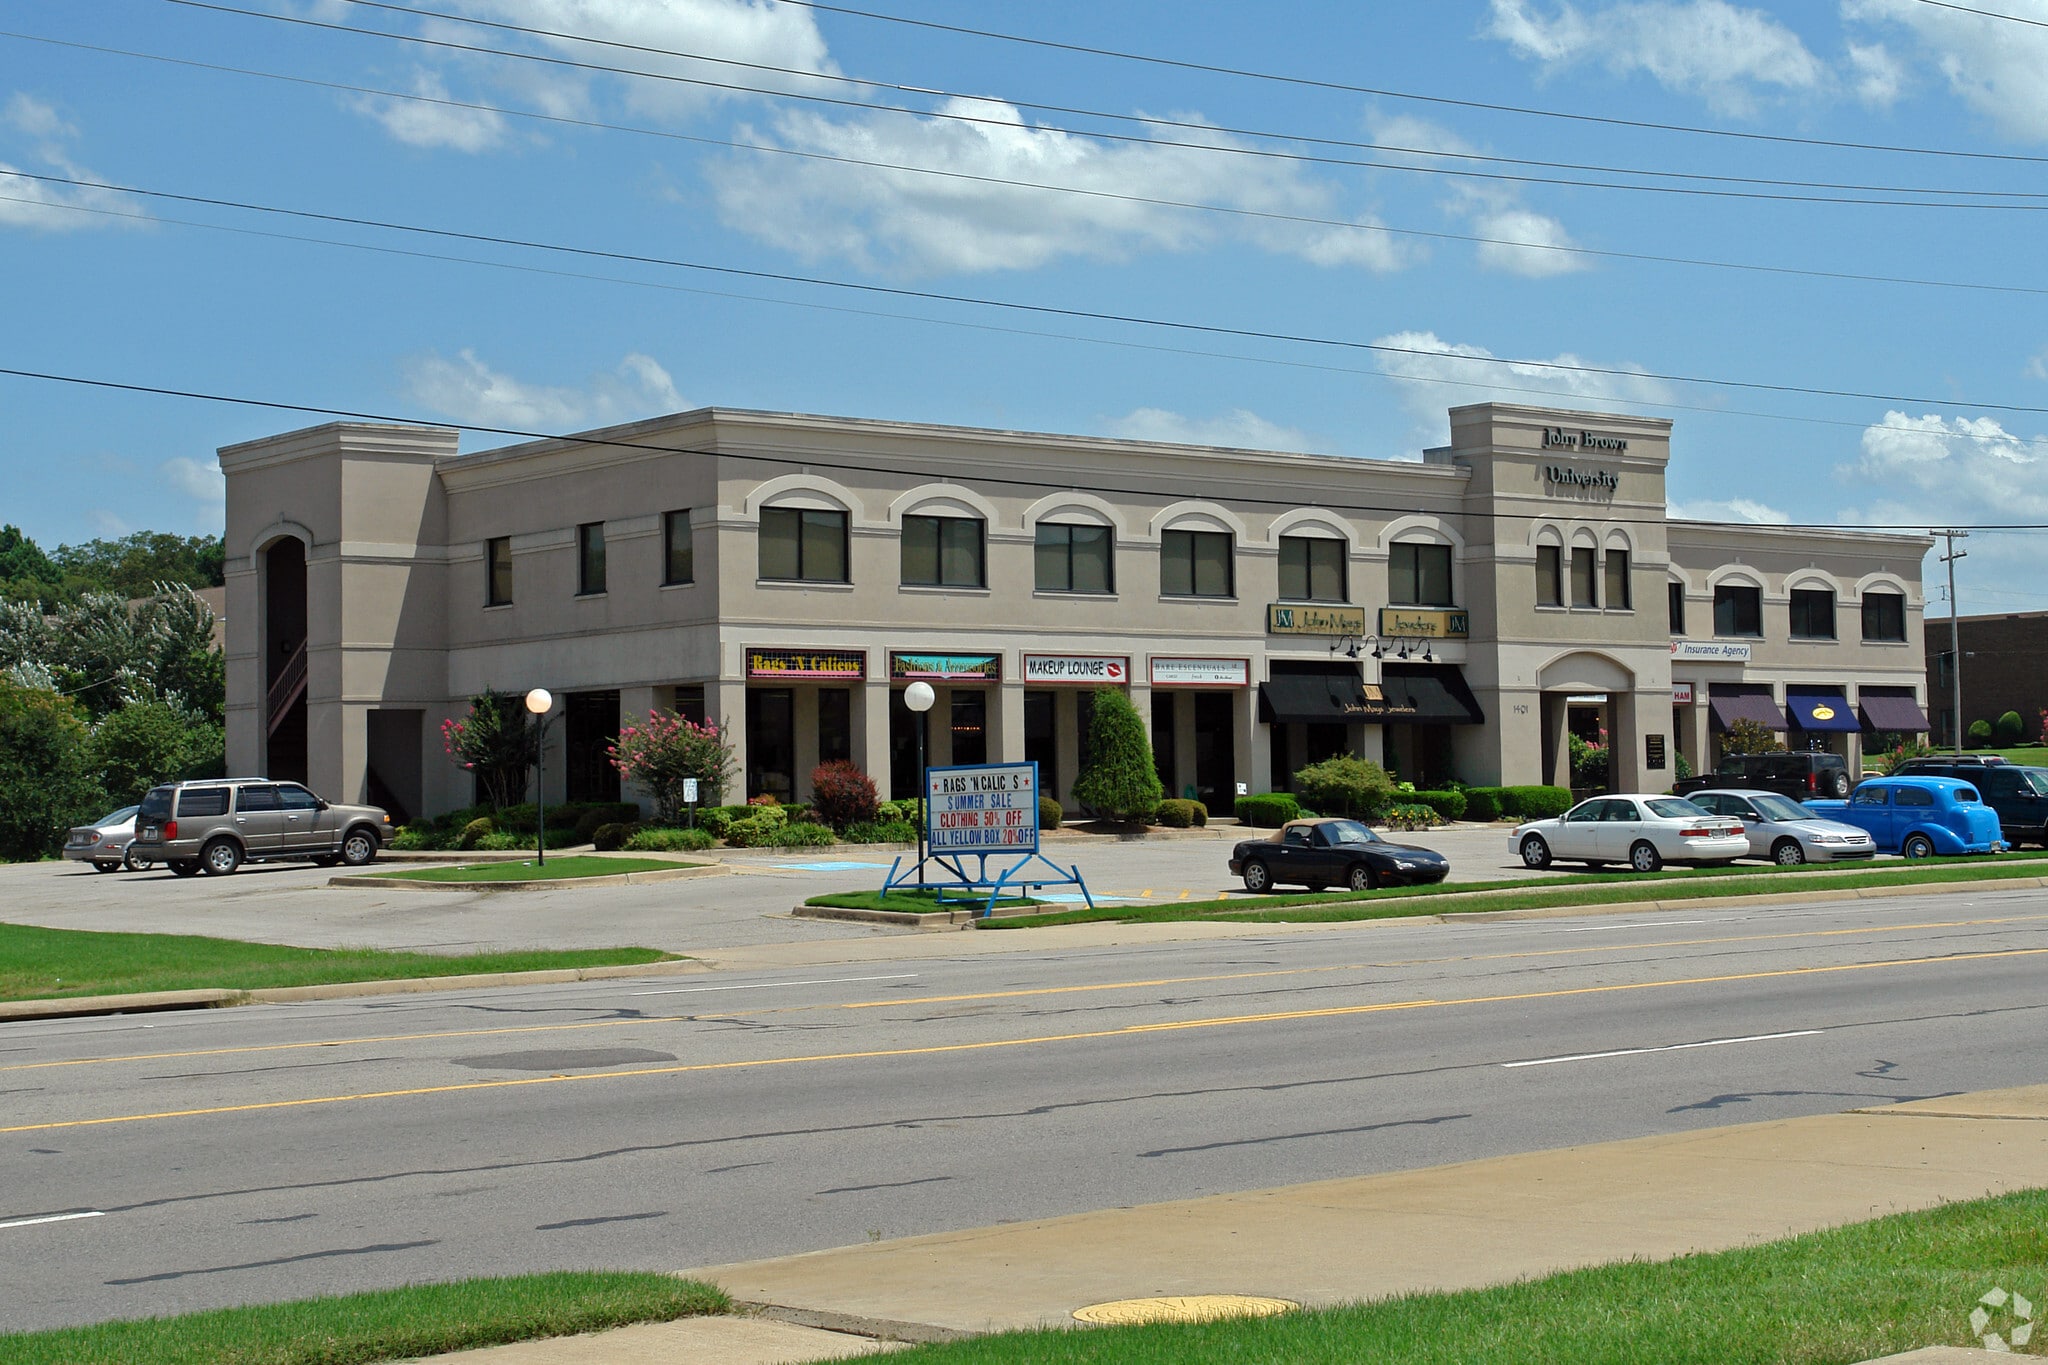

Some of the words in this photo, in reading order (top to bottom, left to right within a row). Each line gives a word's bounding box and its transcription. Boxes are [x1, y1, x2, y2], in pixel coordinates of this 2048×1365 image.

[1542, 428, 1578, 449] John
[1581, 431, 1628, 450] Brown
[1547, 466, 1619, 493] University
[1684, 644, 1719, 655] Insurance
[1721, 645, 1749, 657] Agency
[752, 655, 787, 672] Rags
[810, 656, 860, 672] Calicos
[1029, 660, 1065, 675] MAKEUP
[1067, 661, 1104, 676] LOUNGE
[1674, 691, 1690, 700] HAM
[1343, 703, 1363, 713] John
[943, 777, 966, 793] RAGS
[947, 794, 985, 811] SUMMER
[990, 793, 1012, 808] SALE
[940, 811, 978, 828] CLOTHING
[984, 811, 1000, 826] 50%
[1005, 810, 1022, 826] OFF
[931, 831, 947, 846] ALL
[950, 829, 982, 845] YELLOW
[984, 828, 1000, 844] BOX
[1002, 828, 1018, 845] 20%
[1018, 827, 1034, 843] OFF
